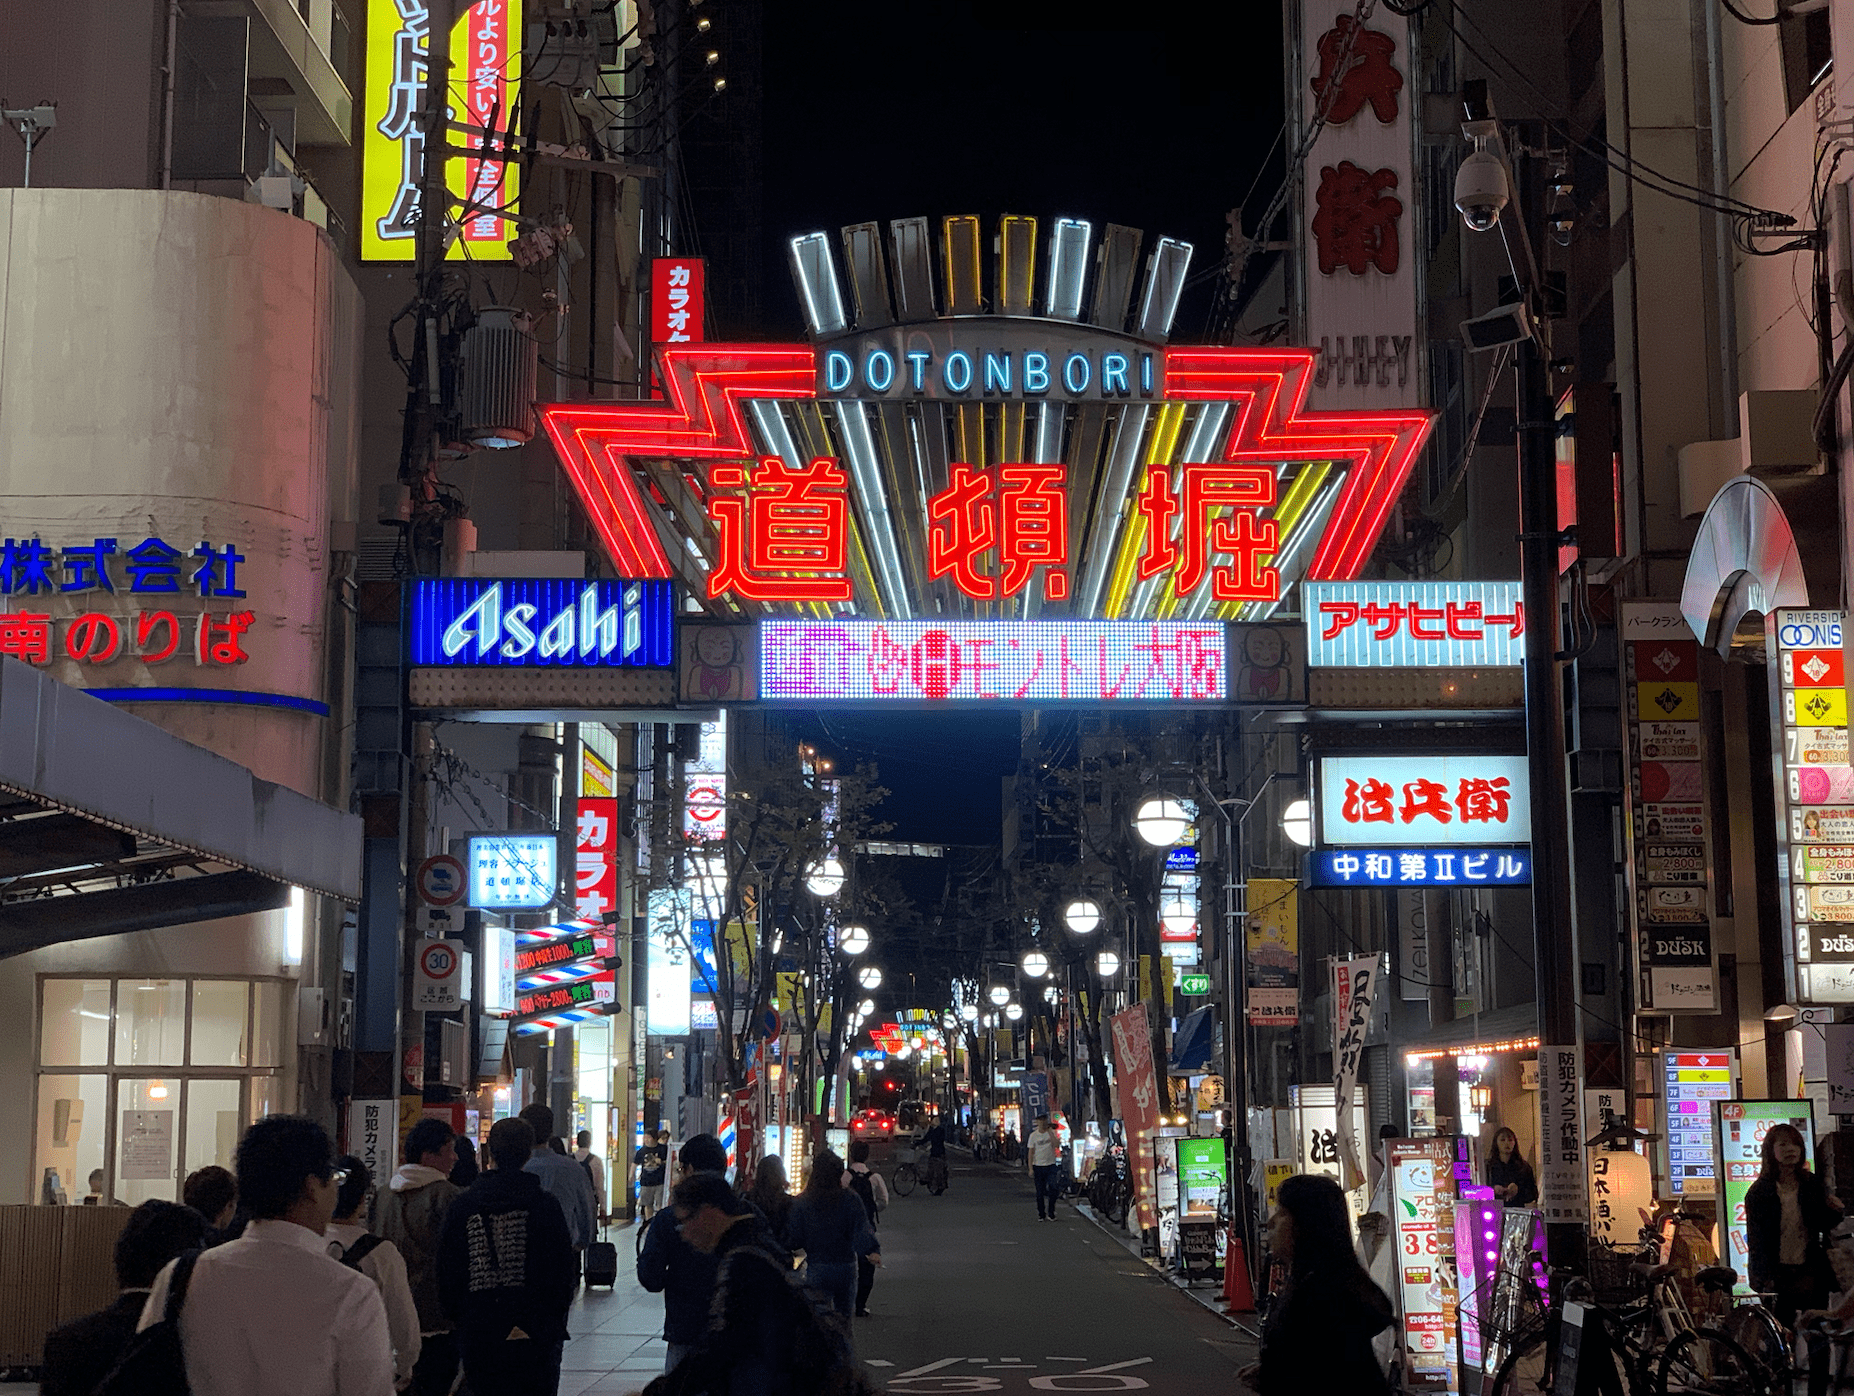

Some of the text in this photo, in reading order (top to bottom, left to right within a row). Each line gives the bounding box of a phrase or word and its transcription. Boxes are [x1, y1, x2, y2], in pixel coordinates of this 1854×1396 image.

[826, 350, 1154, 398] DOTONBORI
[707, 455, 1282, 603] 道頓堀
[0, 538, 247, 599] 株式会社
[442, 581, 642, 659] Asahi
[0, 609, 256, 664] 南のりば
[1784, 654, 1793, 683] 9
[1786, 693, 1795, 722] 8
[1787, 731, 1797, 760] 7
[1790, 770, 1800, 800] 6
[1341, 776, 1511, 824] 治兵衛
[1792, 810, 1802, 840] 5
[1795, 849, 1804, 879] 4
[1796, 888, 1806, 919] 3
[1799, 928, 1809, 959] 2
[429, 953, 449, 969] 30
[1183, 977, 1208, 992] くすり
[420, 995, 455, 1004] ここから
[1668, 1056, 1676, 1065] 9F
[1668, 1072, 1677, 1081] 8F
[1669, 1088, 1678, 1097] 7F
[1558, 1052, 1579, 1165] 防犯カメラ作動中
[1670, 1104, 1679, 1112] 6F
[1725, 1106, 1740, 1117] 4F
[1671, 1120, 1679, 1128] 5F
[1671, 1136, 1680, 1144] 4F
[1672, 1151, 1681, 1160] 3F
[1673, 1167, 1682, 1175] 2F
[1674, 1182, 1682, 1190] 1F
